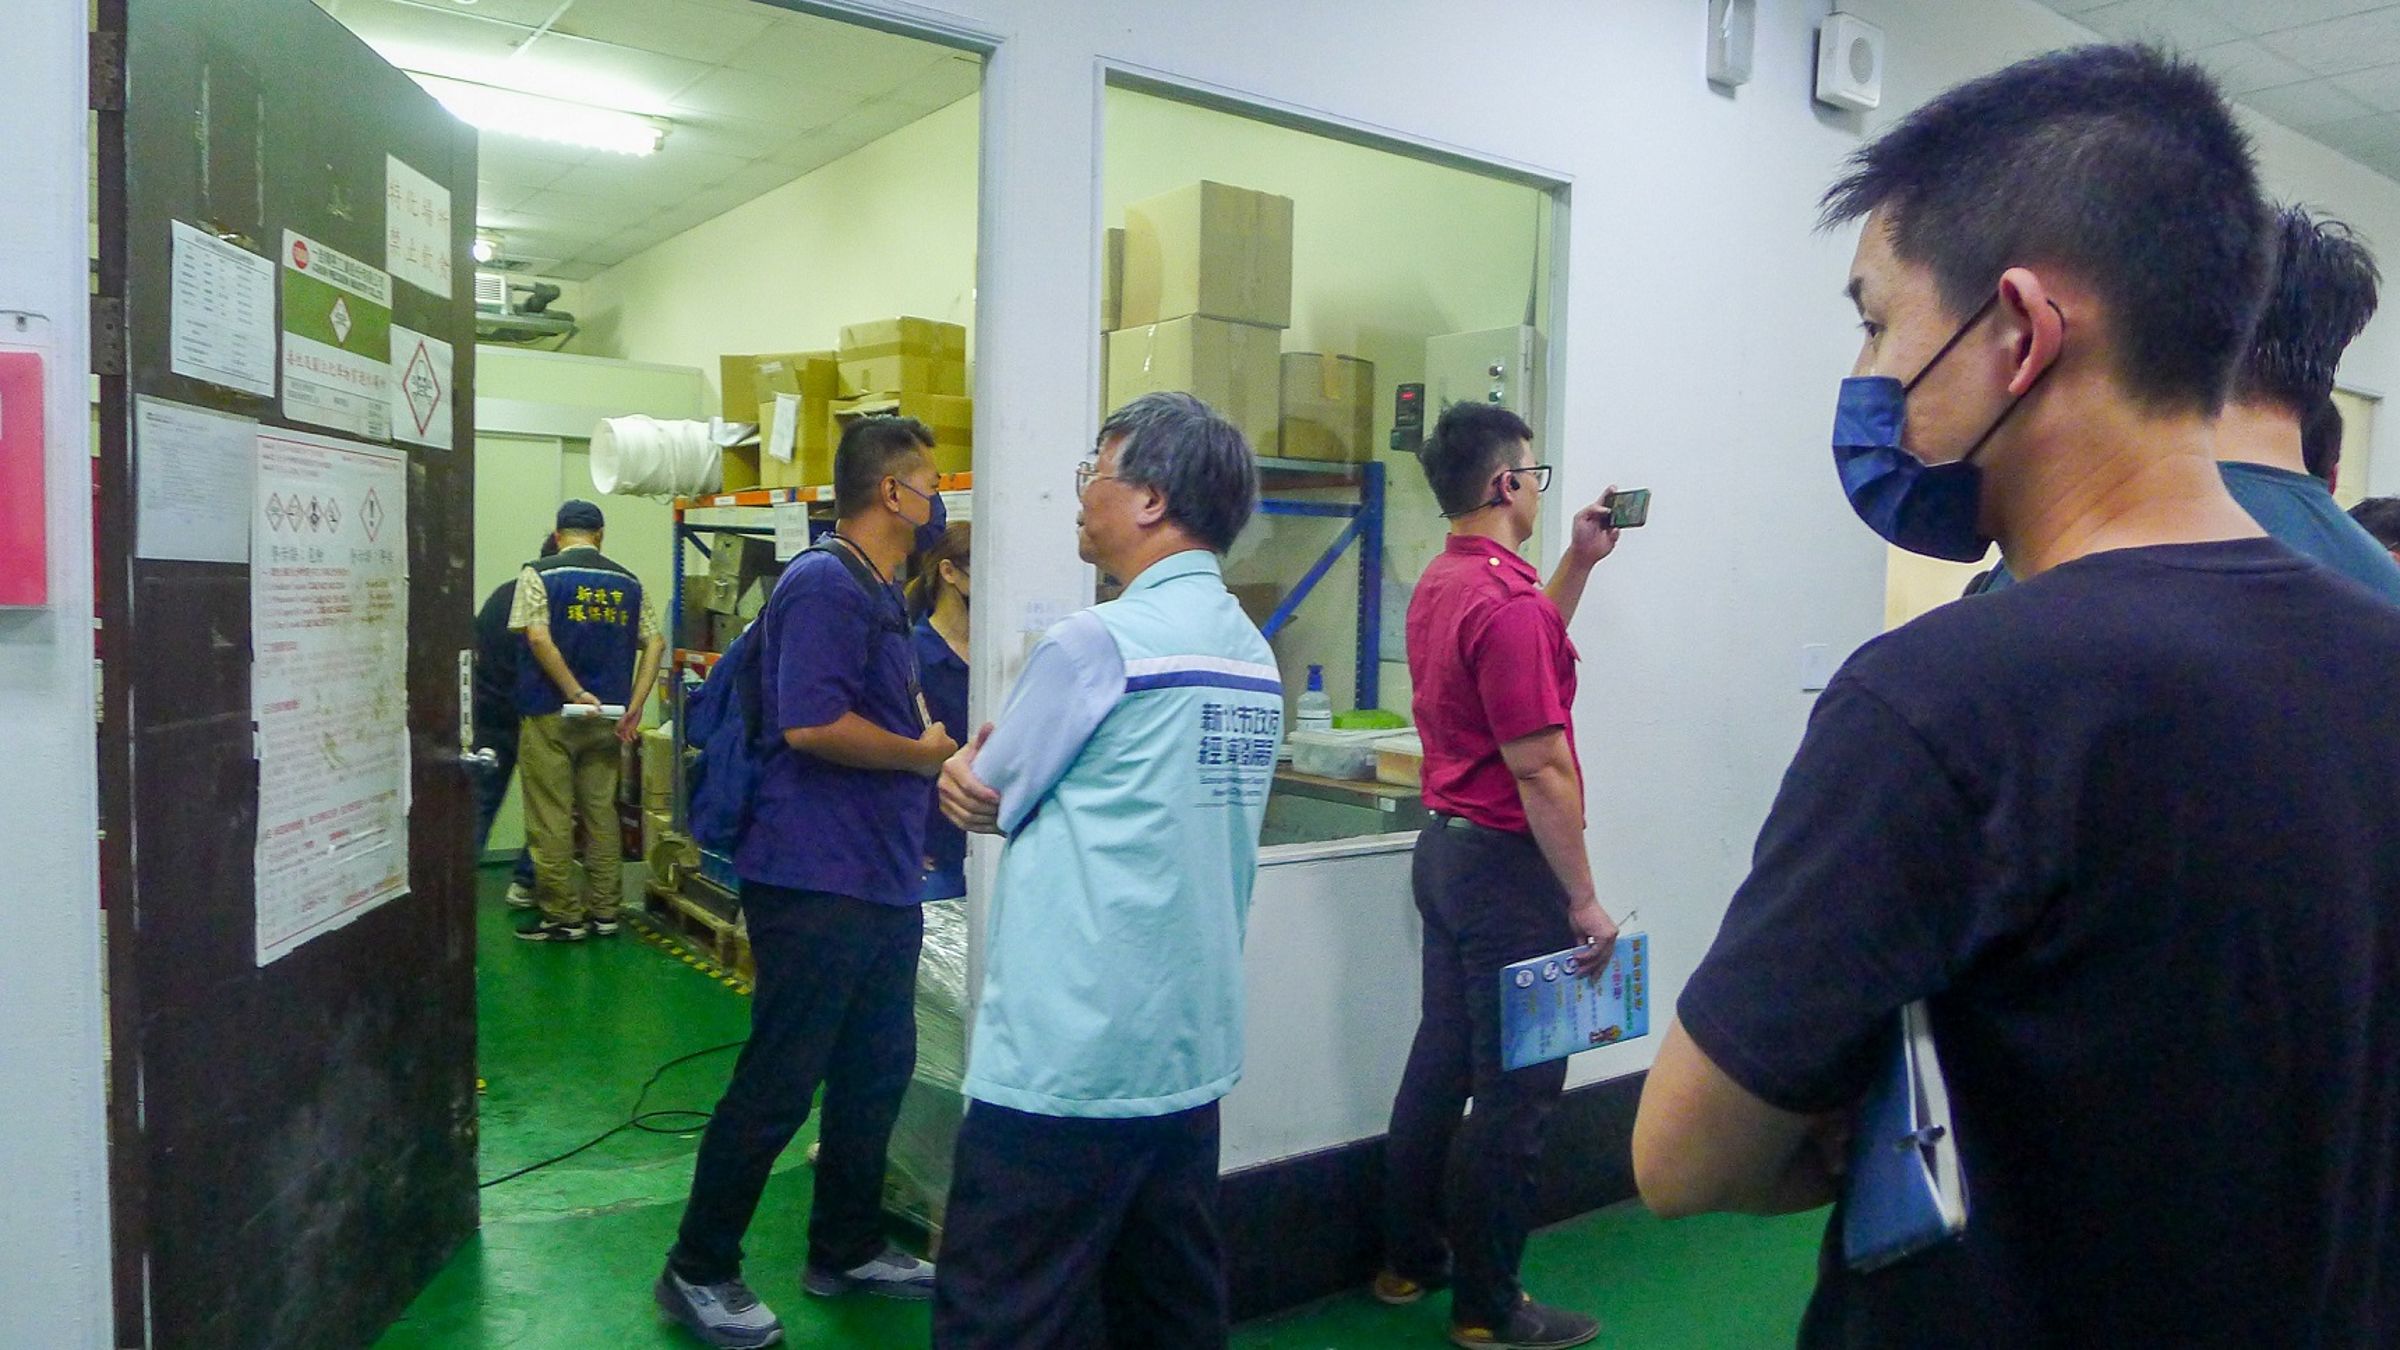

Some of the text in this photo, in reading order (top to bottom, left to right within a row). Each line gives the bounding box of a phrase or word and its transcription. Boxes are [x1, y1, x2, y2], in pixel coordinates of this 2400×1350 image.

[576, 585, 624, 604] 新北市
[1201, 703, 1280, 735] 新北市政府
[1197, 736, 1275, 767] 經濟發展局
